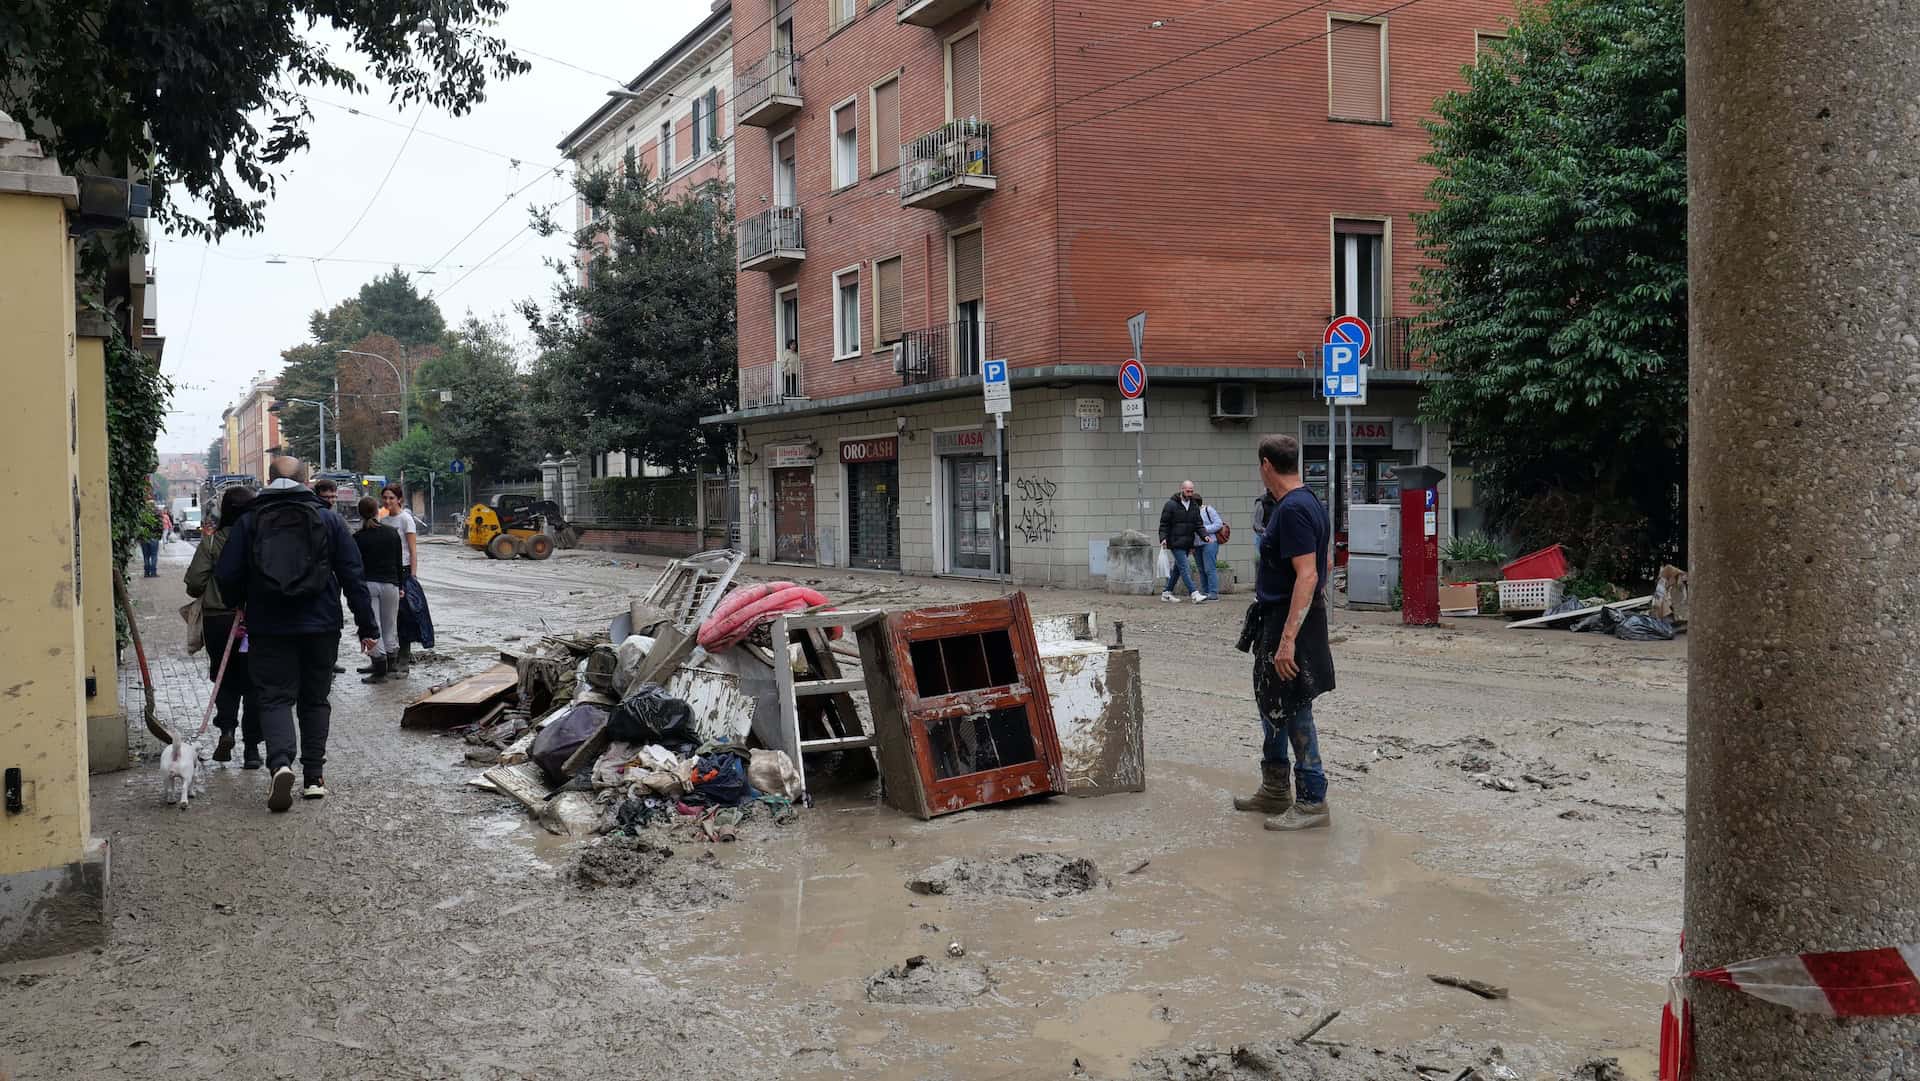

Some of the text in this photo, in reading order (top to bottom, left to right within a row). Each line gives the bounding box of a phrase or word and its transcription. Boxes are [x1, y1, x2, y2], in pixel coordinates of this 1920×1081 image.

[1332, 347, 1352, 372] P
[989, 365, 1000, 380] P
[1426, 491, 1433, 505] P
